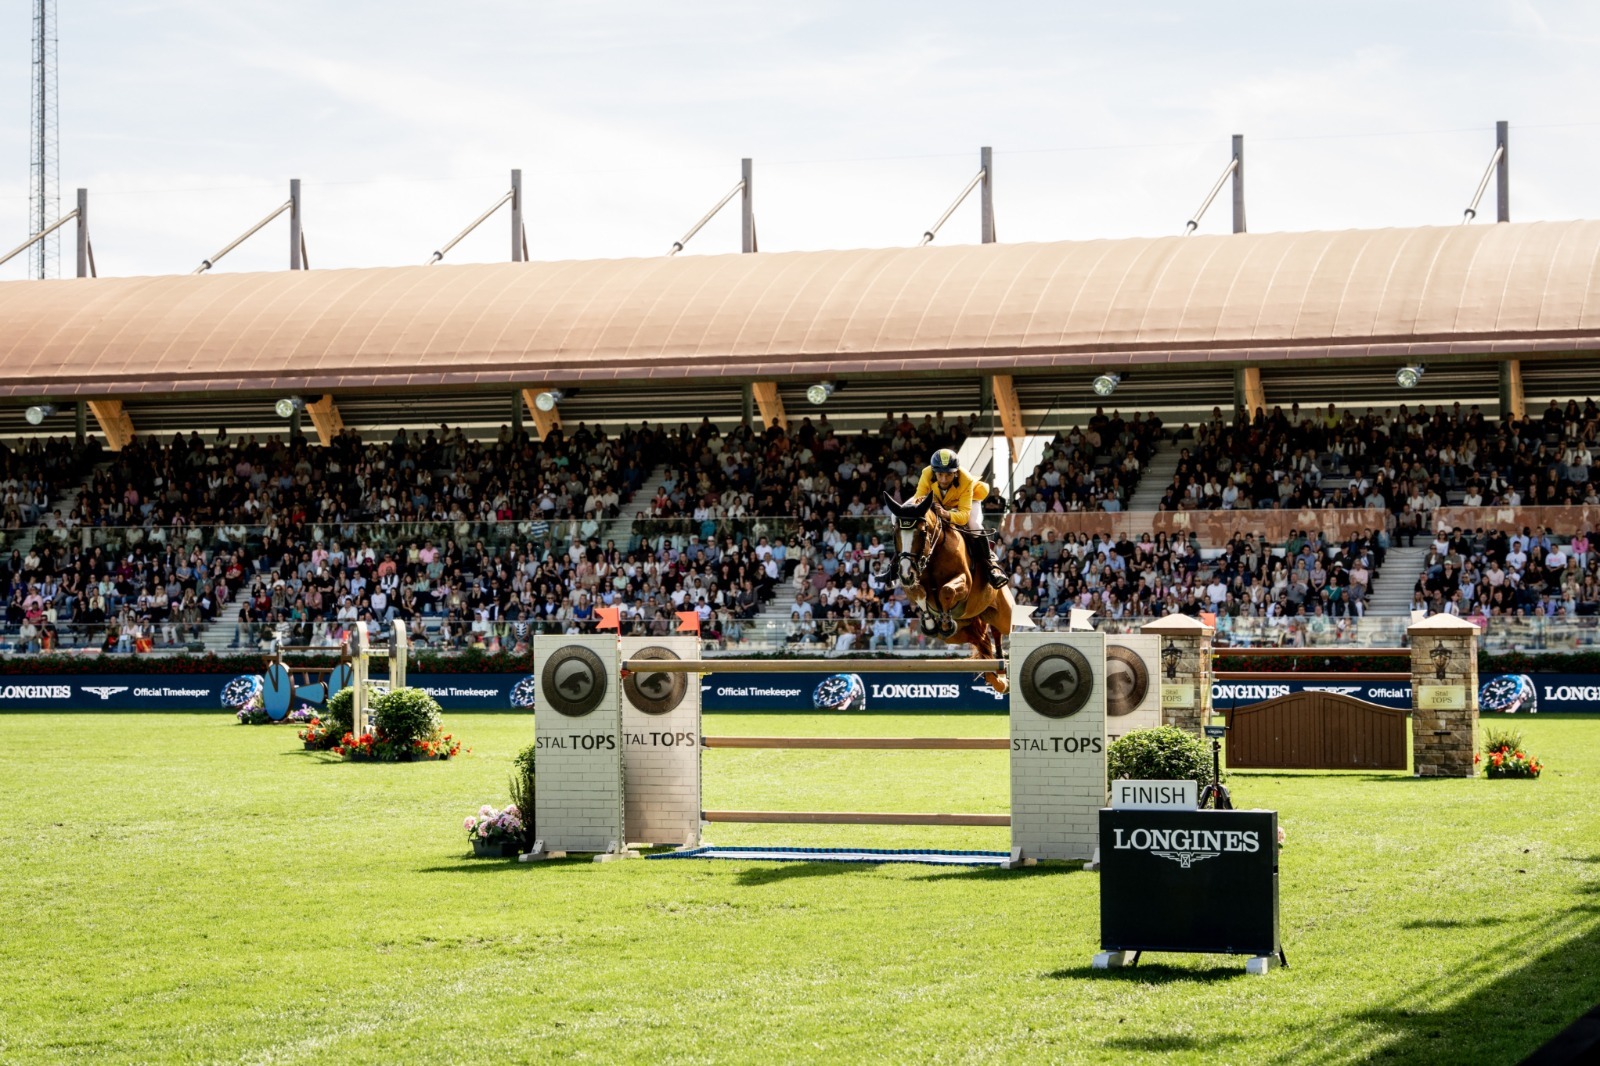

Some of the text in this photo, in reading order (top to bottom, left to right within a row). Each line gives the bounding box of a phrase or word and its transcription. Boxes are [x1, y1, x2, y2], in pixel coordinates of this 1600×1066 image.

[0, 685, 71, 698] LONGINES
[133, 687, 210, 698] Official Timekeeper
[449, 687, 499, 698] Timekeeper
[717, 687, 801, 698] Official Timekeeper
[872, 684, 960, 698] LONGINES
[1211, 685, 1291, 699] ONGINES
[1368, 688, 1404, 698] Official
[1544, 686, 1600, 700] LONG
[1431, 696, 1453, 704] TOPS
[536, 734, 616, 750] STAL TOPS
[623, 732, 695, 747] TAL TOPS
[1013, 738, 1048, 751] STAL
[1050, 737, 1102, 753] TOPS
[1121, 786, 1186, 804] FINISH
[1113, 828, 1260, 852] LONGINES
